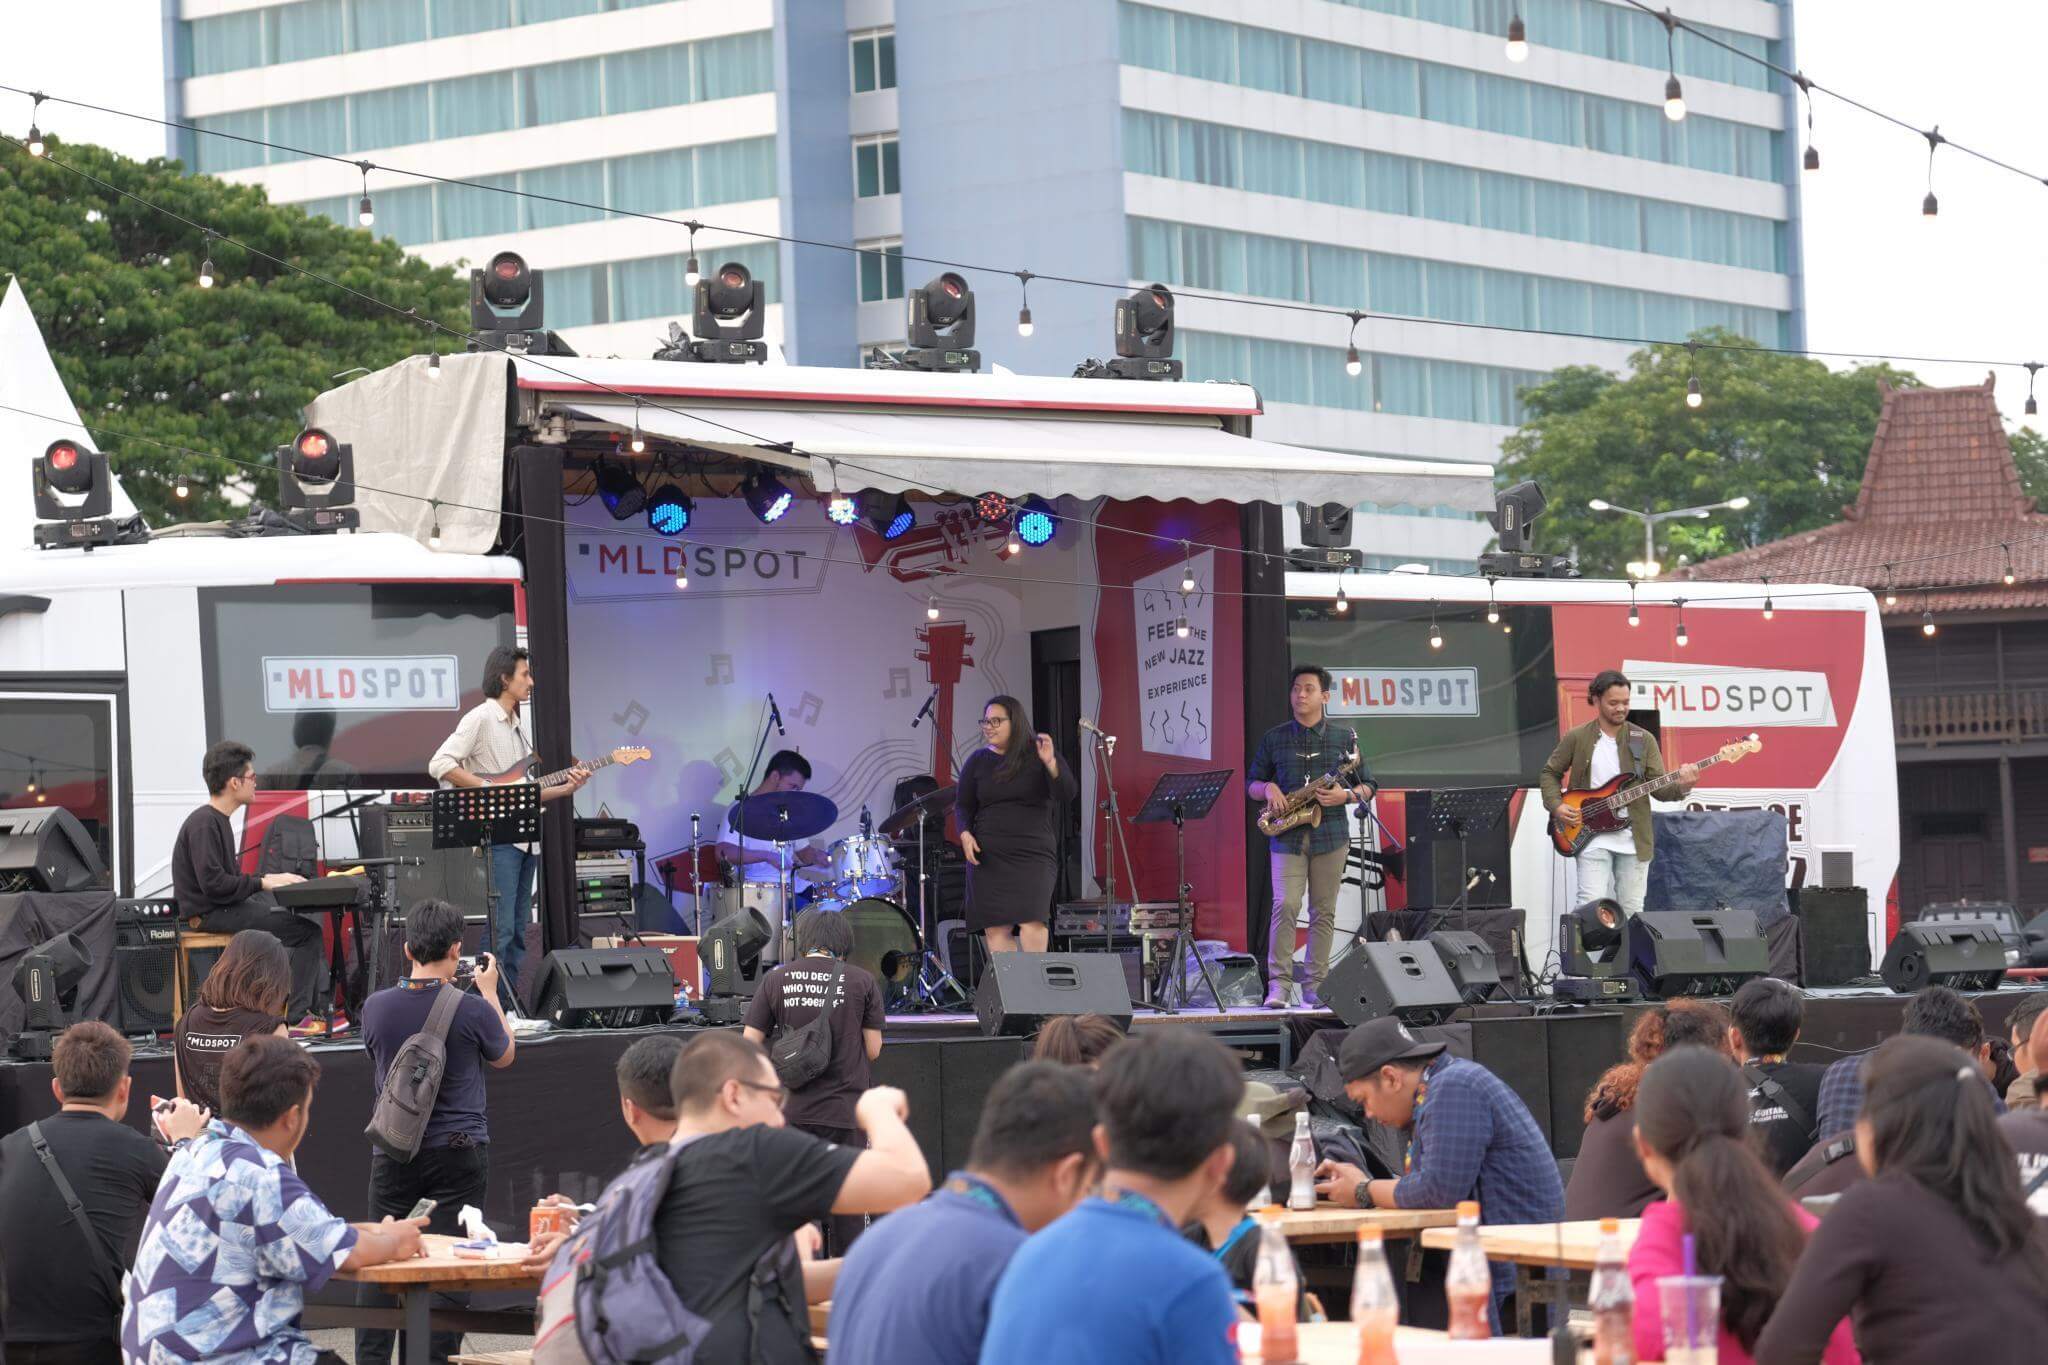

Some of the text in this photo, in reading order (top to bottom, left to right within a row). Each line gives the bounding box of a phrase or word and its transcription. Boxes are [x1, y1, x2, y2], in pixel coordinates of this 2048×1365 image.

[599, 544, 807, 579] MLDSPOT
[1189, 625, 1207, 641] THE
[1145, 648, 1205, 670] NEW JAZZ
[288, 668, 447, 699] MLDSPOT
[1147, 673, 1207, 699] EXPERIENCE
[1341, 678, 1469, 706] MLDSPOT
[1653, 685, 1813, 712] MLDSPOT
[150, 929, 176, 939] Rolan
[783, 984, 803, 994] WHO
[805, 984, 823, 994] YOU
[784, 997, 800, 1008] NOT
[190, 1036, 237, 1048] MLDSPOT
